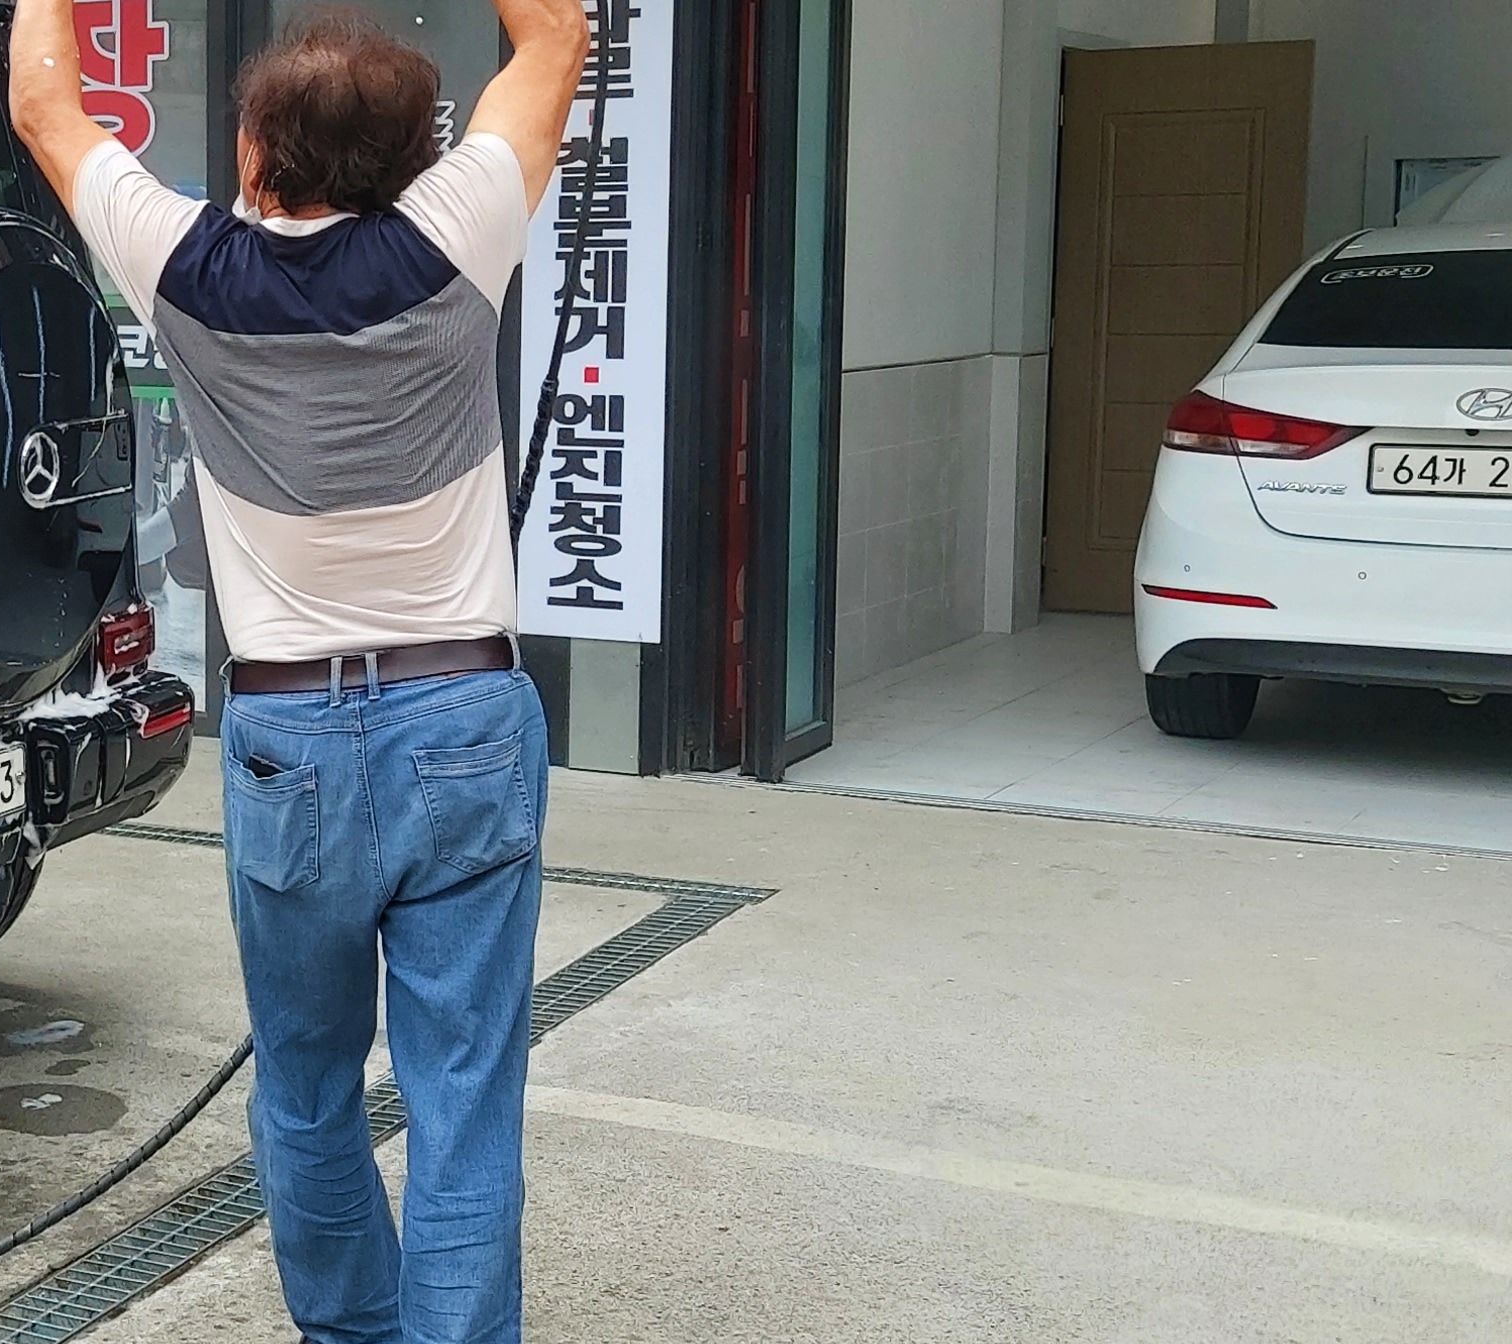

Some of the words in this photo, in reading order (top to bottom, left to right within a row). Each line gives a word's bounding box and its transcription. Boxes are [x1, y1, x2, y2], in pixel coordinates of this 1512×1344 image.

[1393, 454, 1467, 486] 64가
[546, 393, 625, 611] 엔진청소
[1257, 481, 1348, 495] AVANTE
